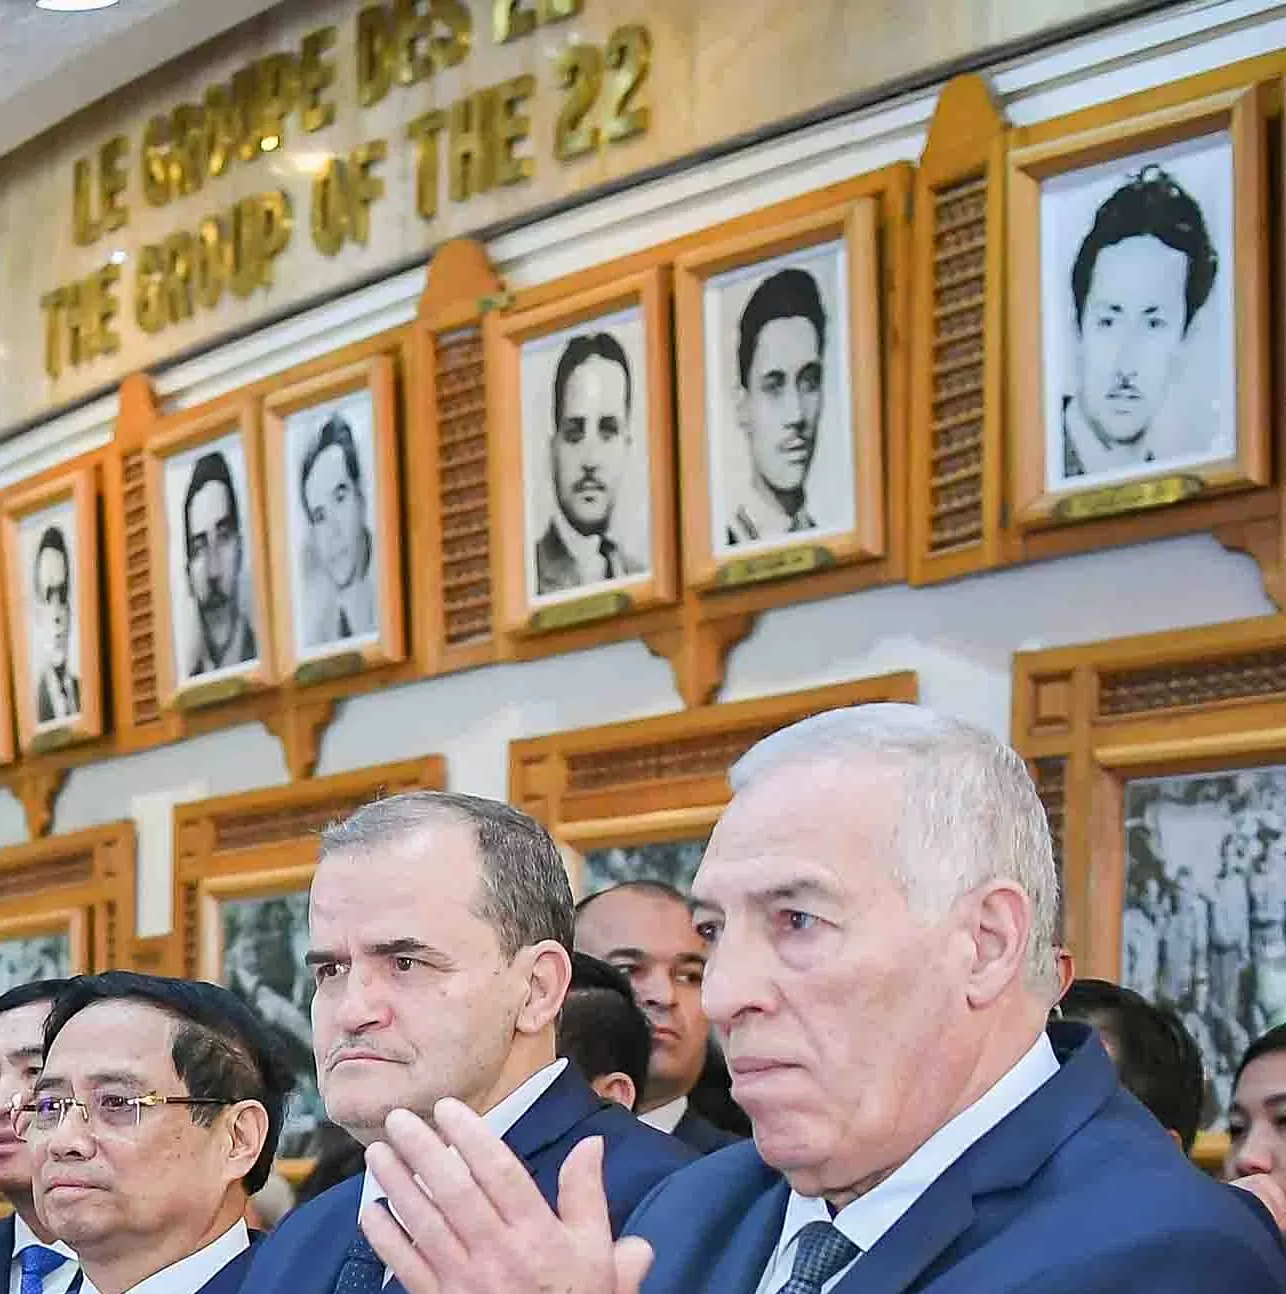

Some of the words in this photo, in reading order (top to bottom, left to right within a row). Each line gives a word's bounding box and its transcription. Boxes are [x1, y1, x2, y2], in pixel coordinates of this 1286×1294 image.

[40, 263, 122, 380] THE
[135, 190, 292, 336] GROUP
[311, 139, 386, 257] OF
[407, 74, 536, 221] THE
[554, 24, 653, 163] 22
[71, 135, 131, 247] LE
[141, 26, 338, 208] GROUPE
[354, 0, 472, 108] DES
